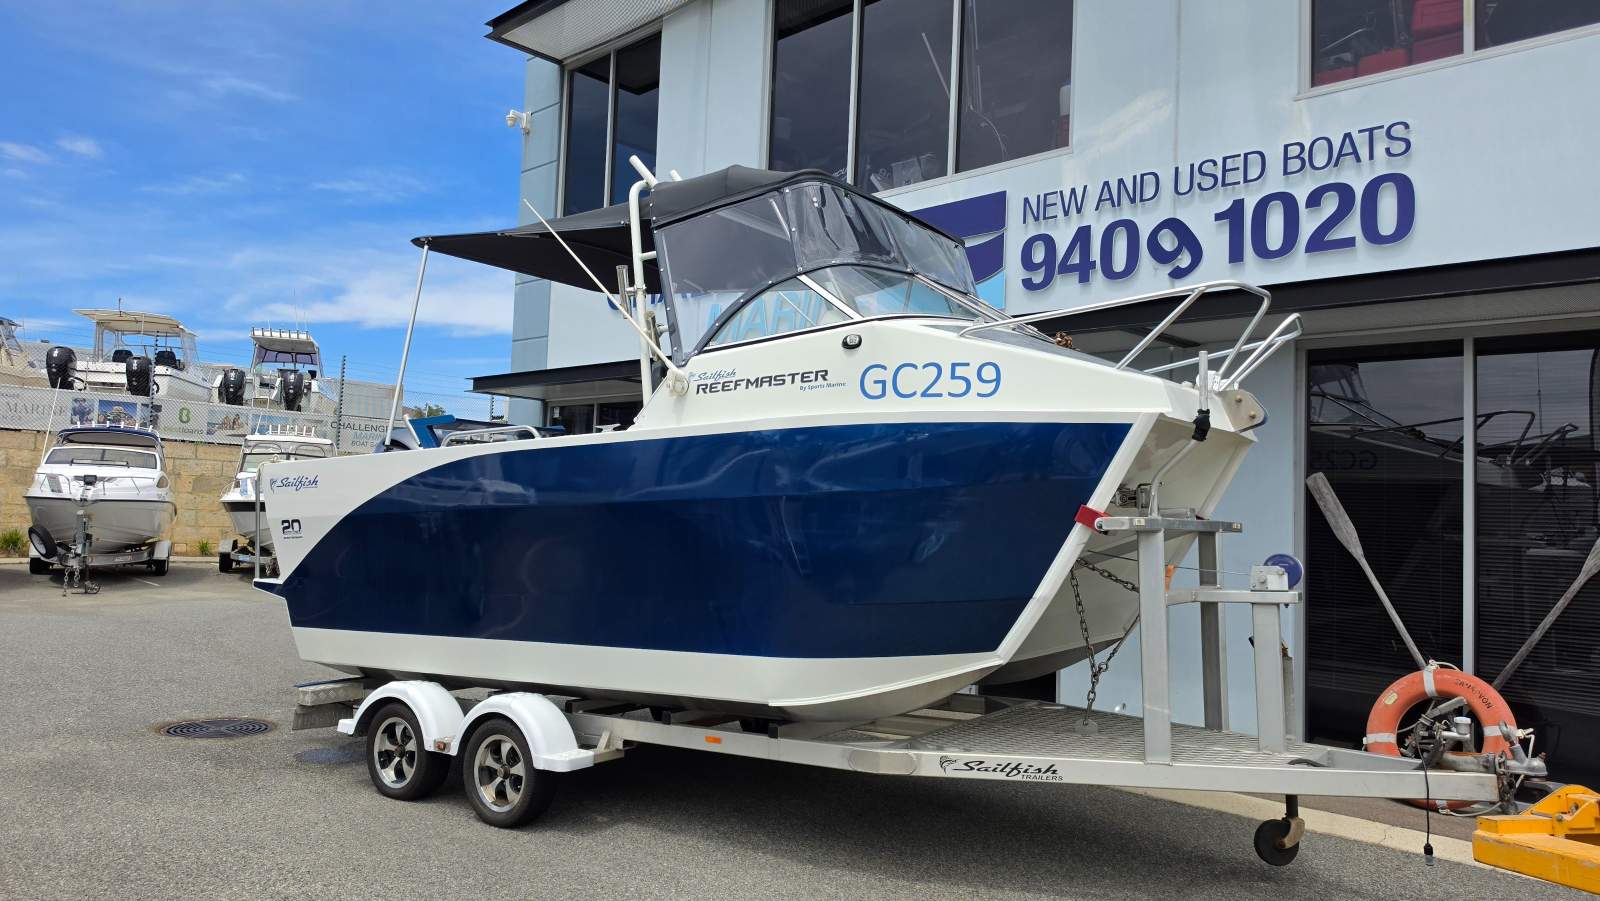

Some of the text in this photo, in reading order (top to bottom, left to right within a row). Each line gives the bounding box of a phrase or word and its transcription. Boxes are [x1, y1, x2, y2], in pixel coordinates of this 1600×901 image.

[1022, 121, 1412, 224] NEW AND USED BOATS
[1020, 172, 1416, 292] 9409 1020
[692, 368, 737, 382] Sailfish
[696, 369, 829, 395] REEFMASTER
[859, 361, 1001, 400] GC259
[807, 383, 825, 391] Sports
[276, 474, 319, 491] Sailfish
[281, 519, 302, 534] 20
[952, 760, 1059, 777] Sailfish
